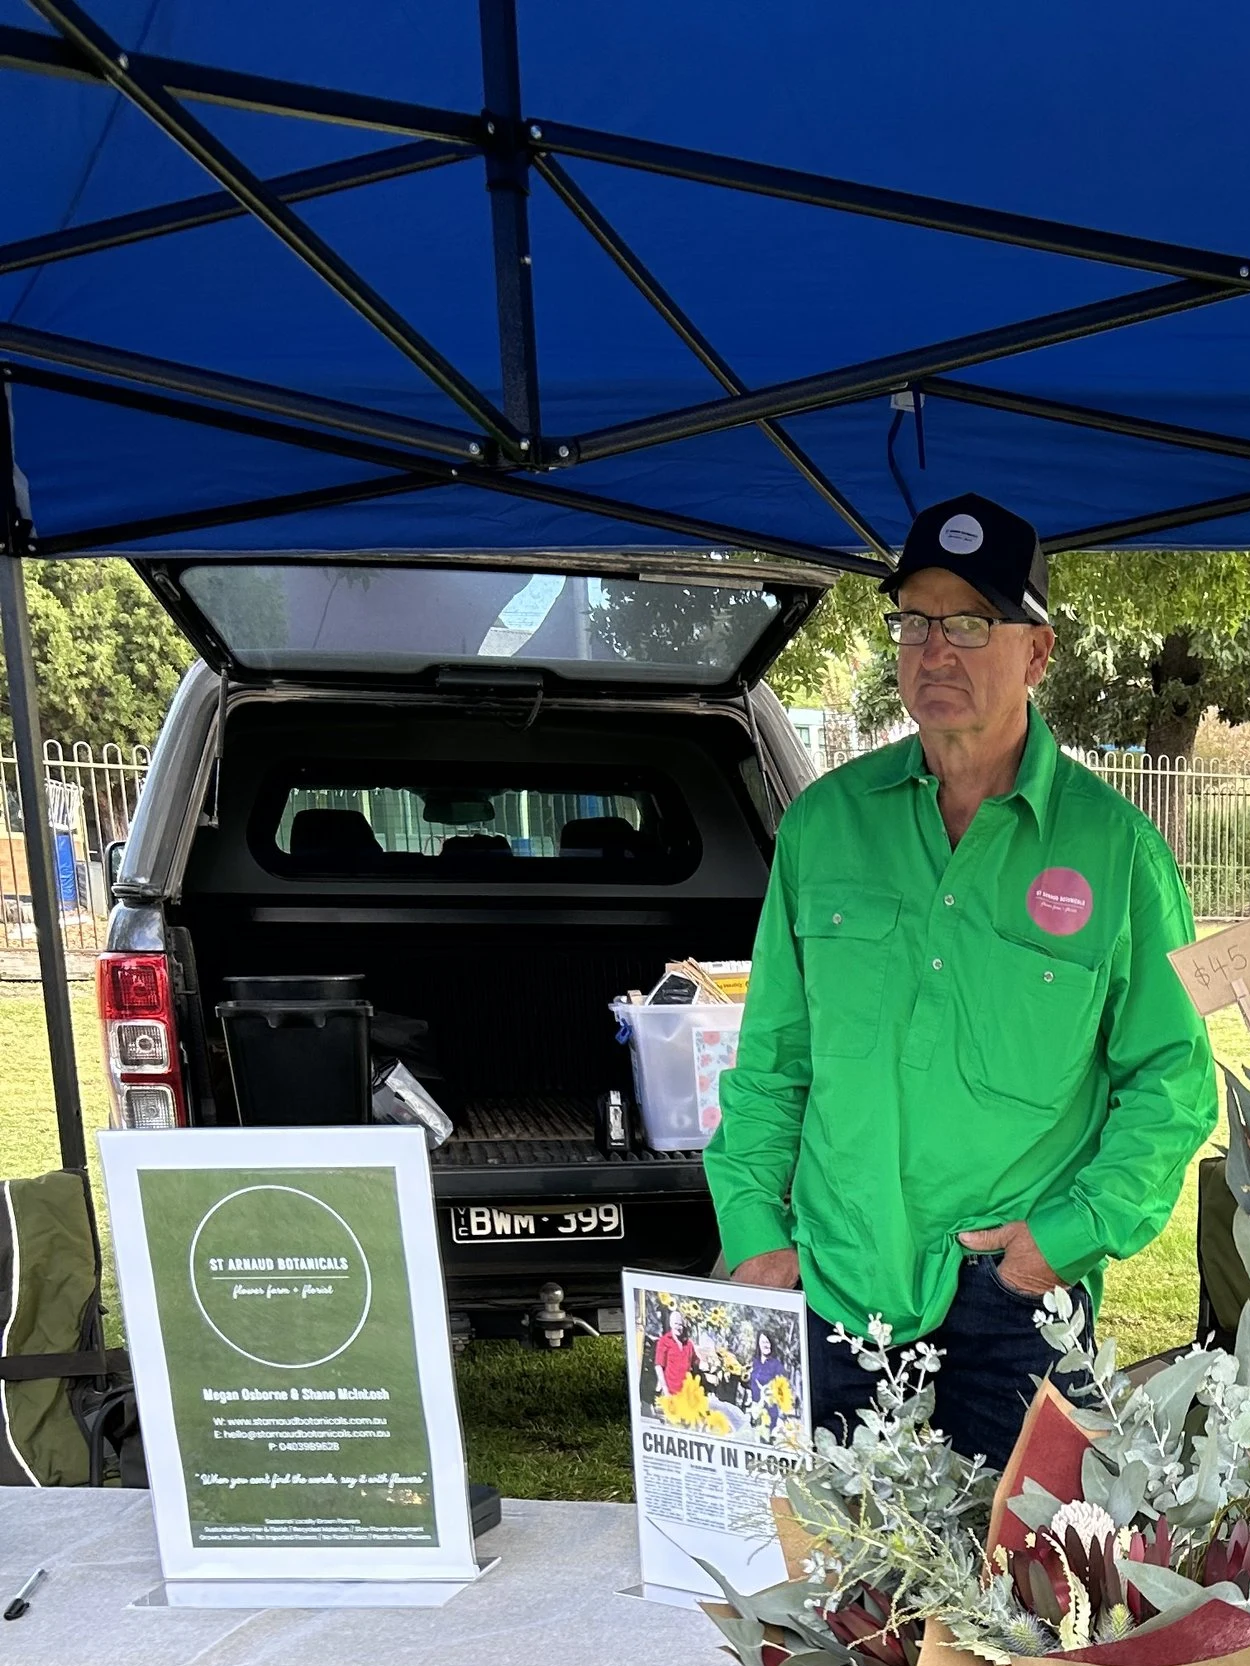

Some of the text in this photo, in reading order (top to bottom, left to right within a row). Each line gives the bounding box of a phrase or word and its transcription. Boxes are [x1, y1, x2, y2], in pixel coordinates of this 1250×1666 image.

[1193, 945, 1248, 990] $45
[458, 1208, 469, 1236] VIC
[470, 1207, 535, 1236] BWM
[209, 1257, 349, 1271] ST ARNAUD BOTANICALS
[232, 1284, 265, 1300] flower
[266, 1284, 291, 1299] farm
[302, 1284, 334, 1299] florist
[203, 1387, 390, 1404] Megan Osborne & Shane McIntosh
[642, 1432, 714, 1464] CHARITY
[720, 1446, 739, 1469] IN
